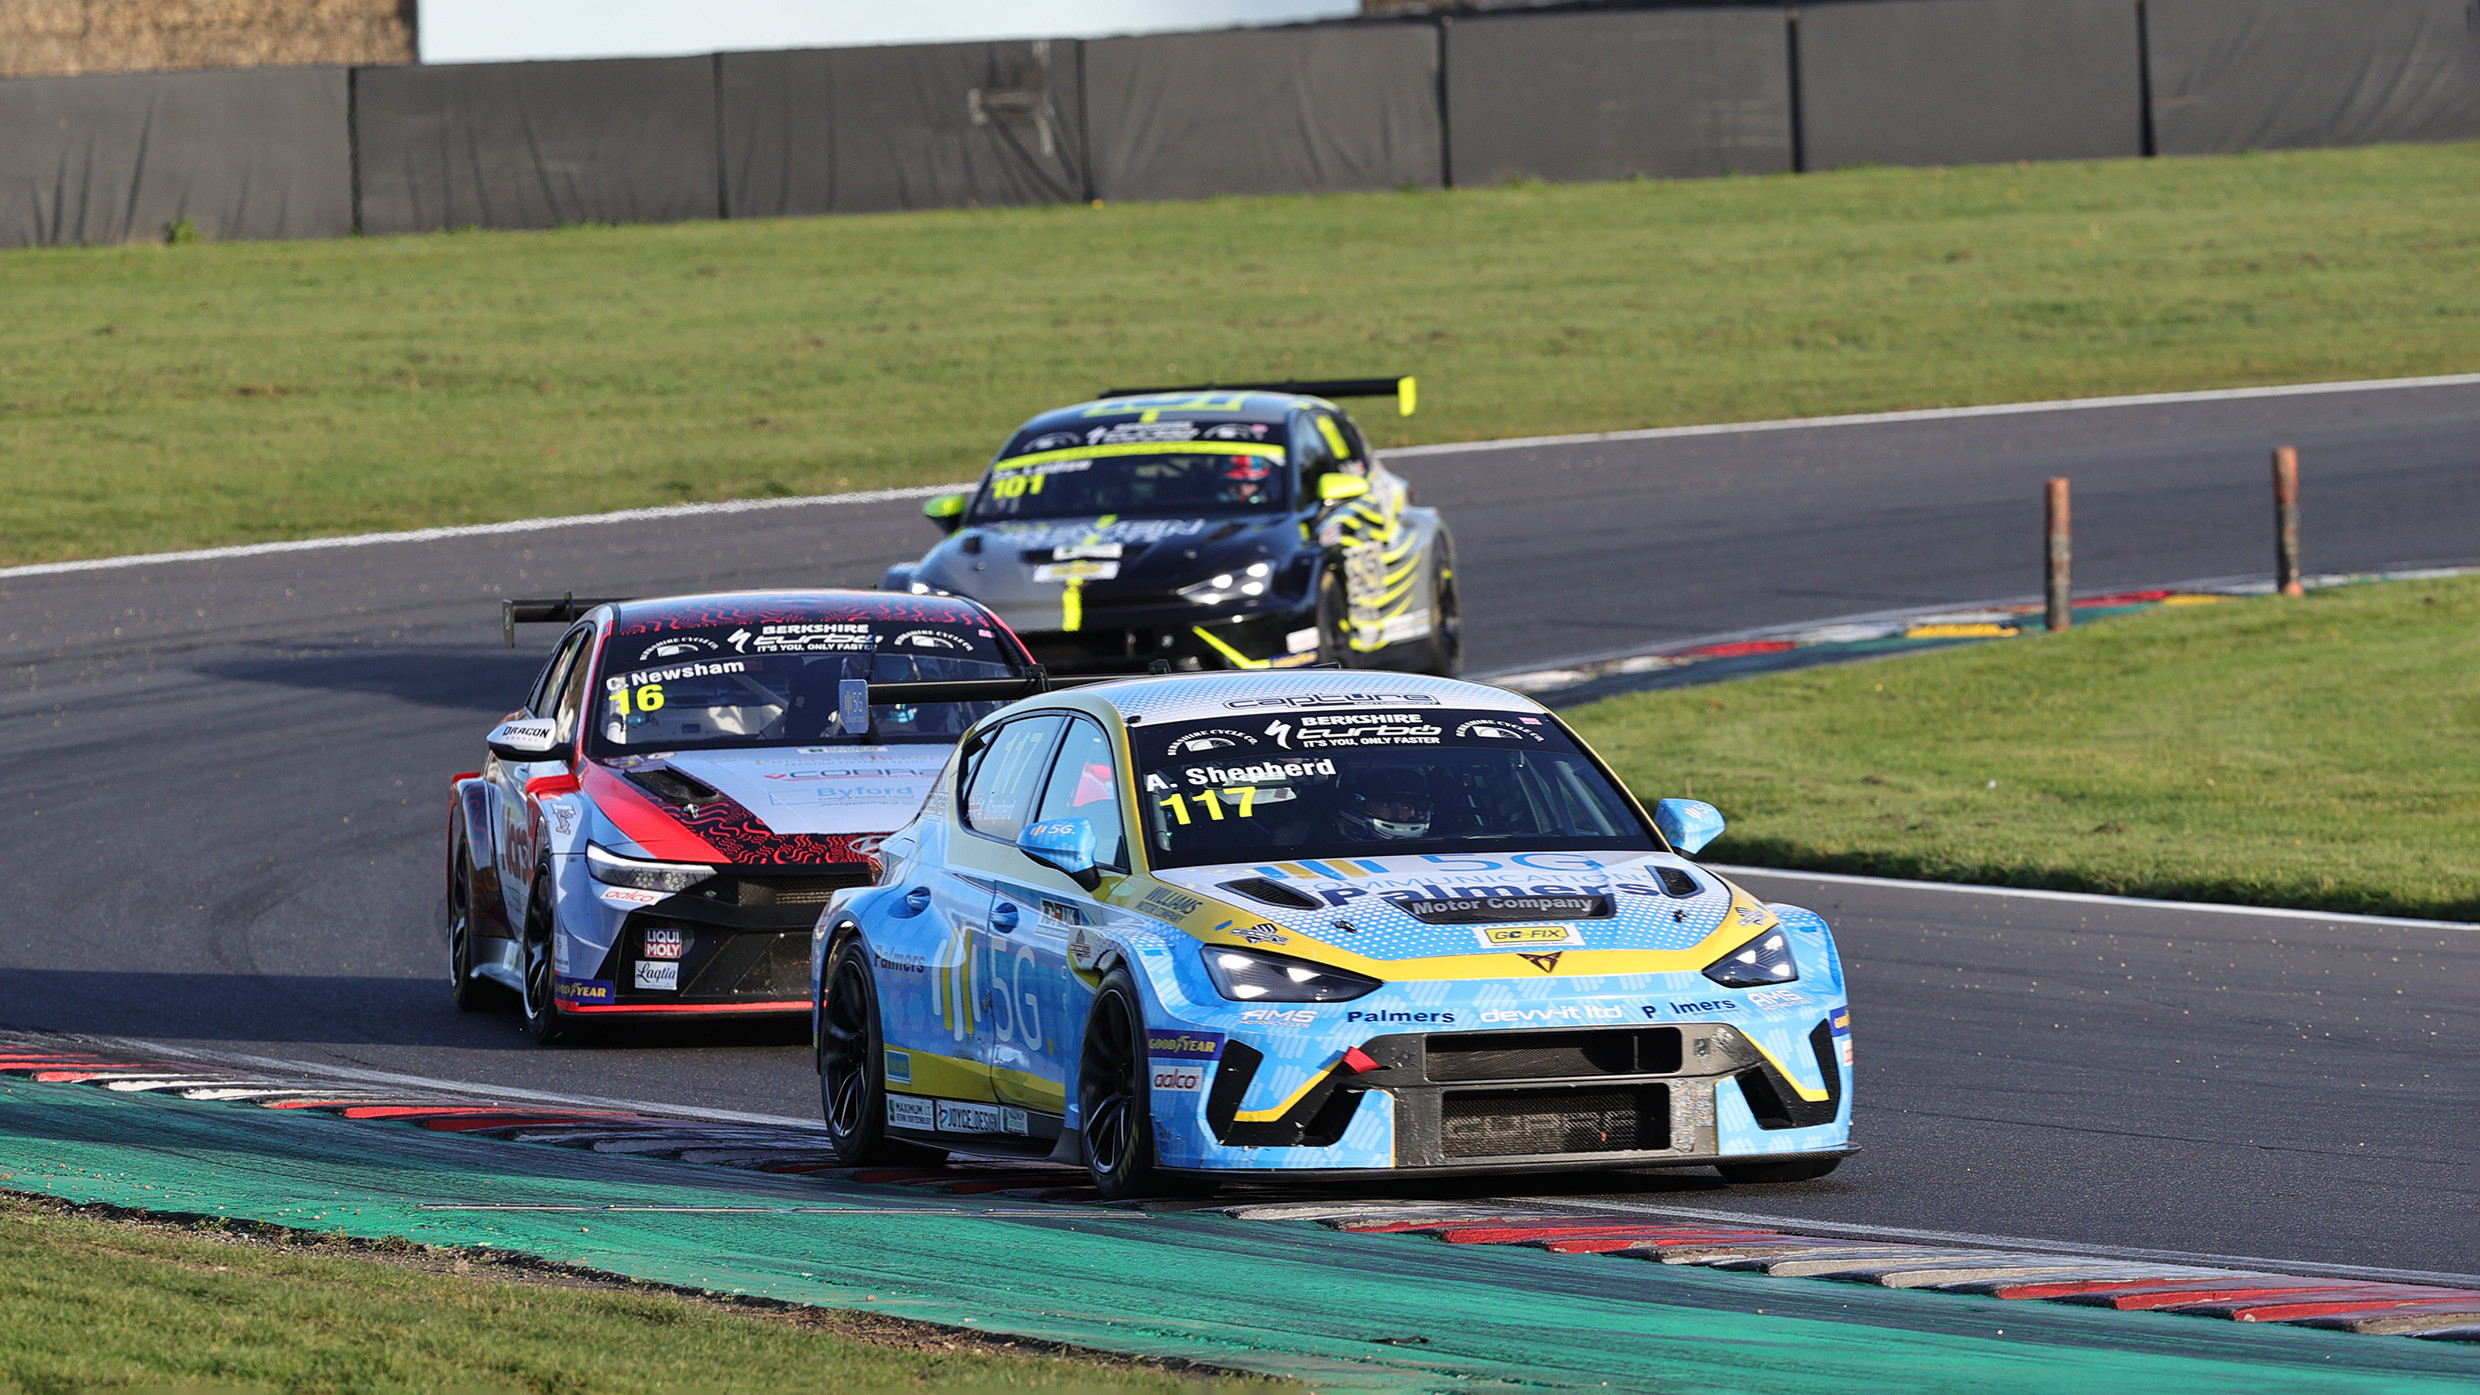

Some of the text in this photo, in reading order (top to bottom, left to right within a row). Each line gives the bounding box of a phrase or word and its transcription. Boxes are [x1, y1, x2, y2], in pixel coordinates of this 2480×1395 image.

[992, 474, 1045, 499] 101
[762, 624, 869, 635] BERKSHIRE
[757, 644, 778, 652] IT'S
[807, 643, 835, 651] ONLY
[606, 661, 745, 692] C. Newsham
[609, 684, 665, 715] 16
[1300, 714, 1423, 727] BERKSHIRE
[1496, 720, 1532, 734] CYCLE
[502, 726, 551, 738] DRAGON
[1296, 725, 1443, 740] turbo
[1167, 729, 1209, 756] BERKSHIRE
[1209, 729, 1246, 739] CYCLE
[1303, 739, 1328, 748] IT'S
[1362, 737, 1395, 745] ONLY
[1394, 736, 1441, 745] FASTER
[991, 731, 1044, 795] 117
[1146, 758, 1337, 792] A. Shepherd
[816, 786, 914, 797] Byford
[1159, 786, 1256, 826] 117
[1419, 853, 1606, 872] 5G
[1298, 872, 1653, 892] COMMUNICATIONS
[604, 889, 656, 903] aalco
[1144, 886, 1204, 915] WILLIAMS
[1318, 884, 1659, 907] Palmers
[1412, 898, 1594, 915] Motor Company
[646, 929, 680, 944] LIQUI
[645, 944, 681, 957] MOLY
[991, 935, 1043, 1051] 5G
[1747, 990, 1805, 1008] AMS
[1239, 1010, 1318, 1023] AMS
[1347, 1009, 1455, 1023] Palmers
[1584, 1004, 1622, 1020] ltd
[1148, 1036, 1216, 1053] GOODYEAR
[1154, 1068, 1197, 1089] aalco
